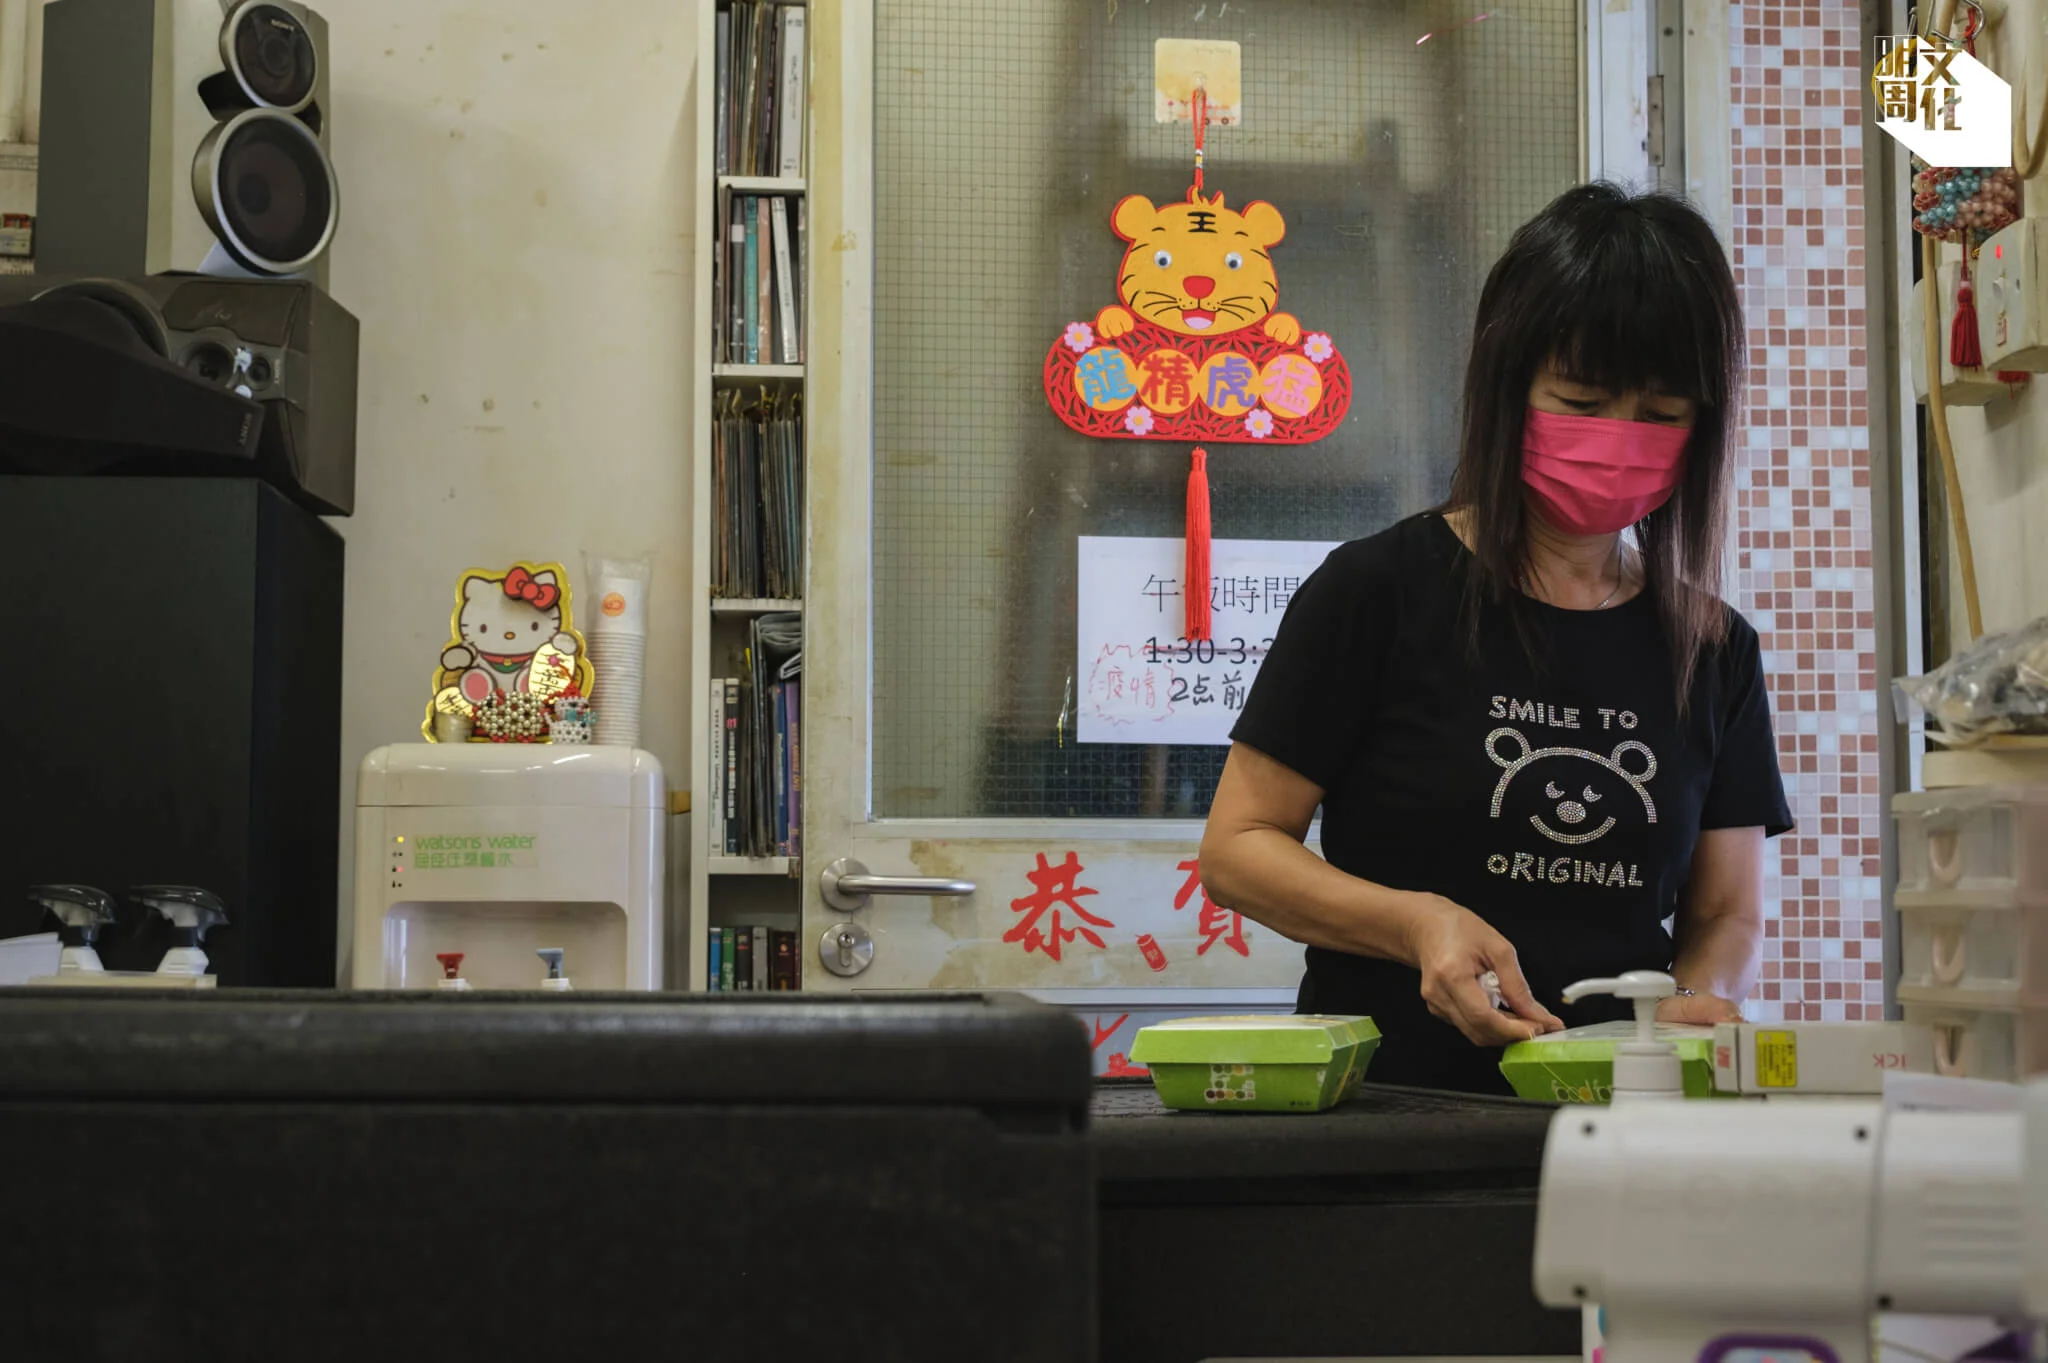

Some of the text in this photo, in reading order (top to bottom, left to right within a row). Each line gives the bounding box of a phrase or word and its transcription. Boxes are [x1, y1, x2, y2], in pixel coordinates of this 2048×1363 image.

[1076, 348, 1318, 416] 龍精虎猛
[1488, 695, 1639, 730] SMILE TO
[415, 834, 536, 850] watsons water
[1487, 852, 1643, 888] ORIGINAL
